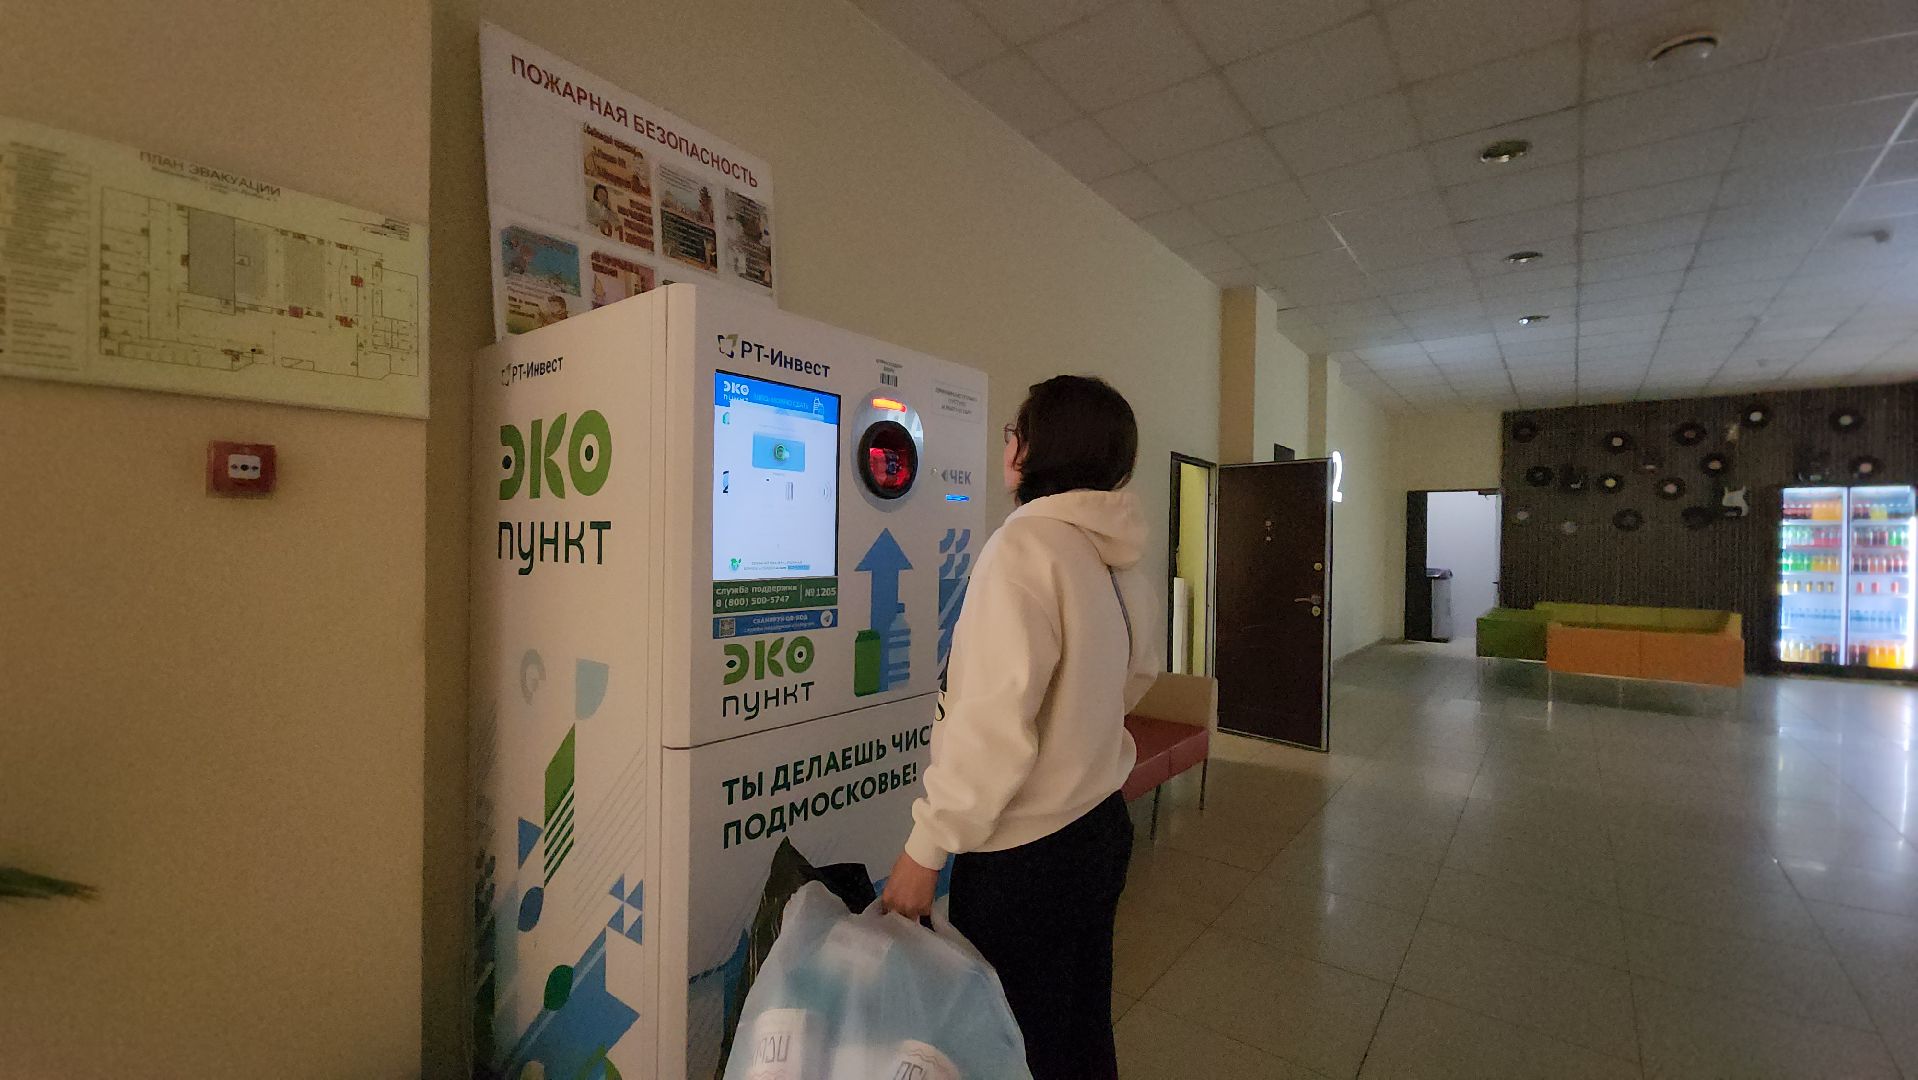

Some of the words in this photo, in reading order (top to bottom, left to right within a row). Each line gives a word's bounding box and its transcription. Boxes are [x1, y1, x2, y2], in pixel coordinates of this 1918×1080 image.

[511, 54, 629, 128] ПОЖАРНАЯ
[633, 114, 758, 188] БЕЗОПАСНОСТЬ
[140, 151, 183, 171] ПЛАН
[189, 165, 280, 196] ЭВАКУАЦИИ
[512, 356, 564, 383] РТ-Инвест
[741, 340, 831, 378] РТ-Инвест
[723, 381, 748, 395] ЭКО
[499, 410, 612, 500] ЭКО
[949, 470, 971, 485] ЧЕК
[717, 586, 749, 598] служба
[752, 584, 797, 595] поддержки
[717, 598, 722, 608] 8
[724, 597, 749, 609] (800)
[751, 595, 790, 606] 500-5747
[723, 636, 815, 685] ЭКО
[722, 771, 763, 806] ТЫ
[770, 738, 887, 797] ДЕЛАЕШЬ
[892, 724, 932, 754] ЧИС
[723, 762, 918, 850] ПОДМОСКОВЬЕ!
